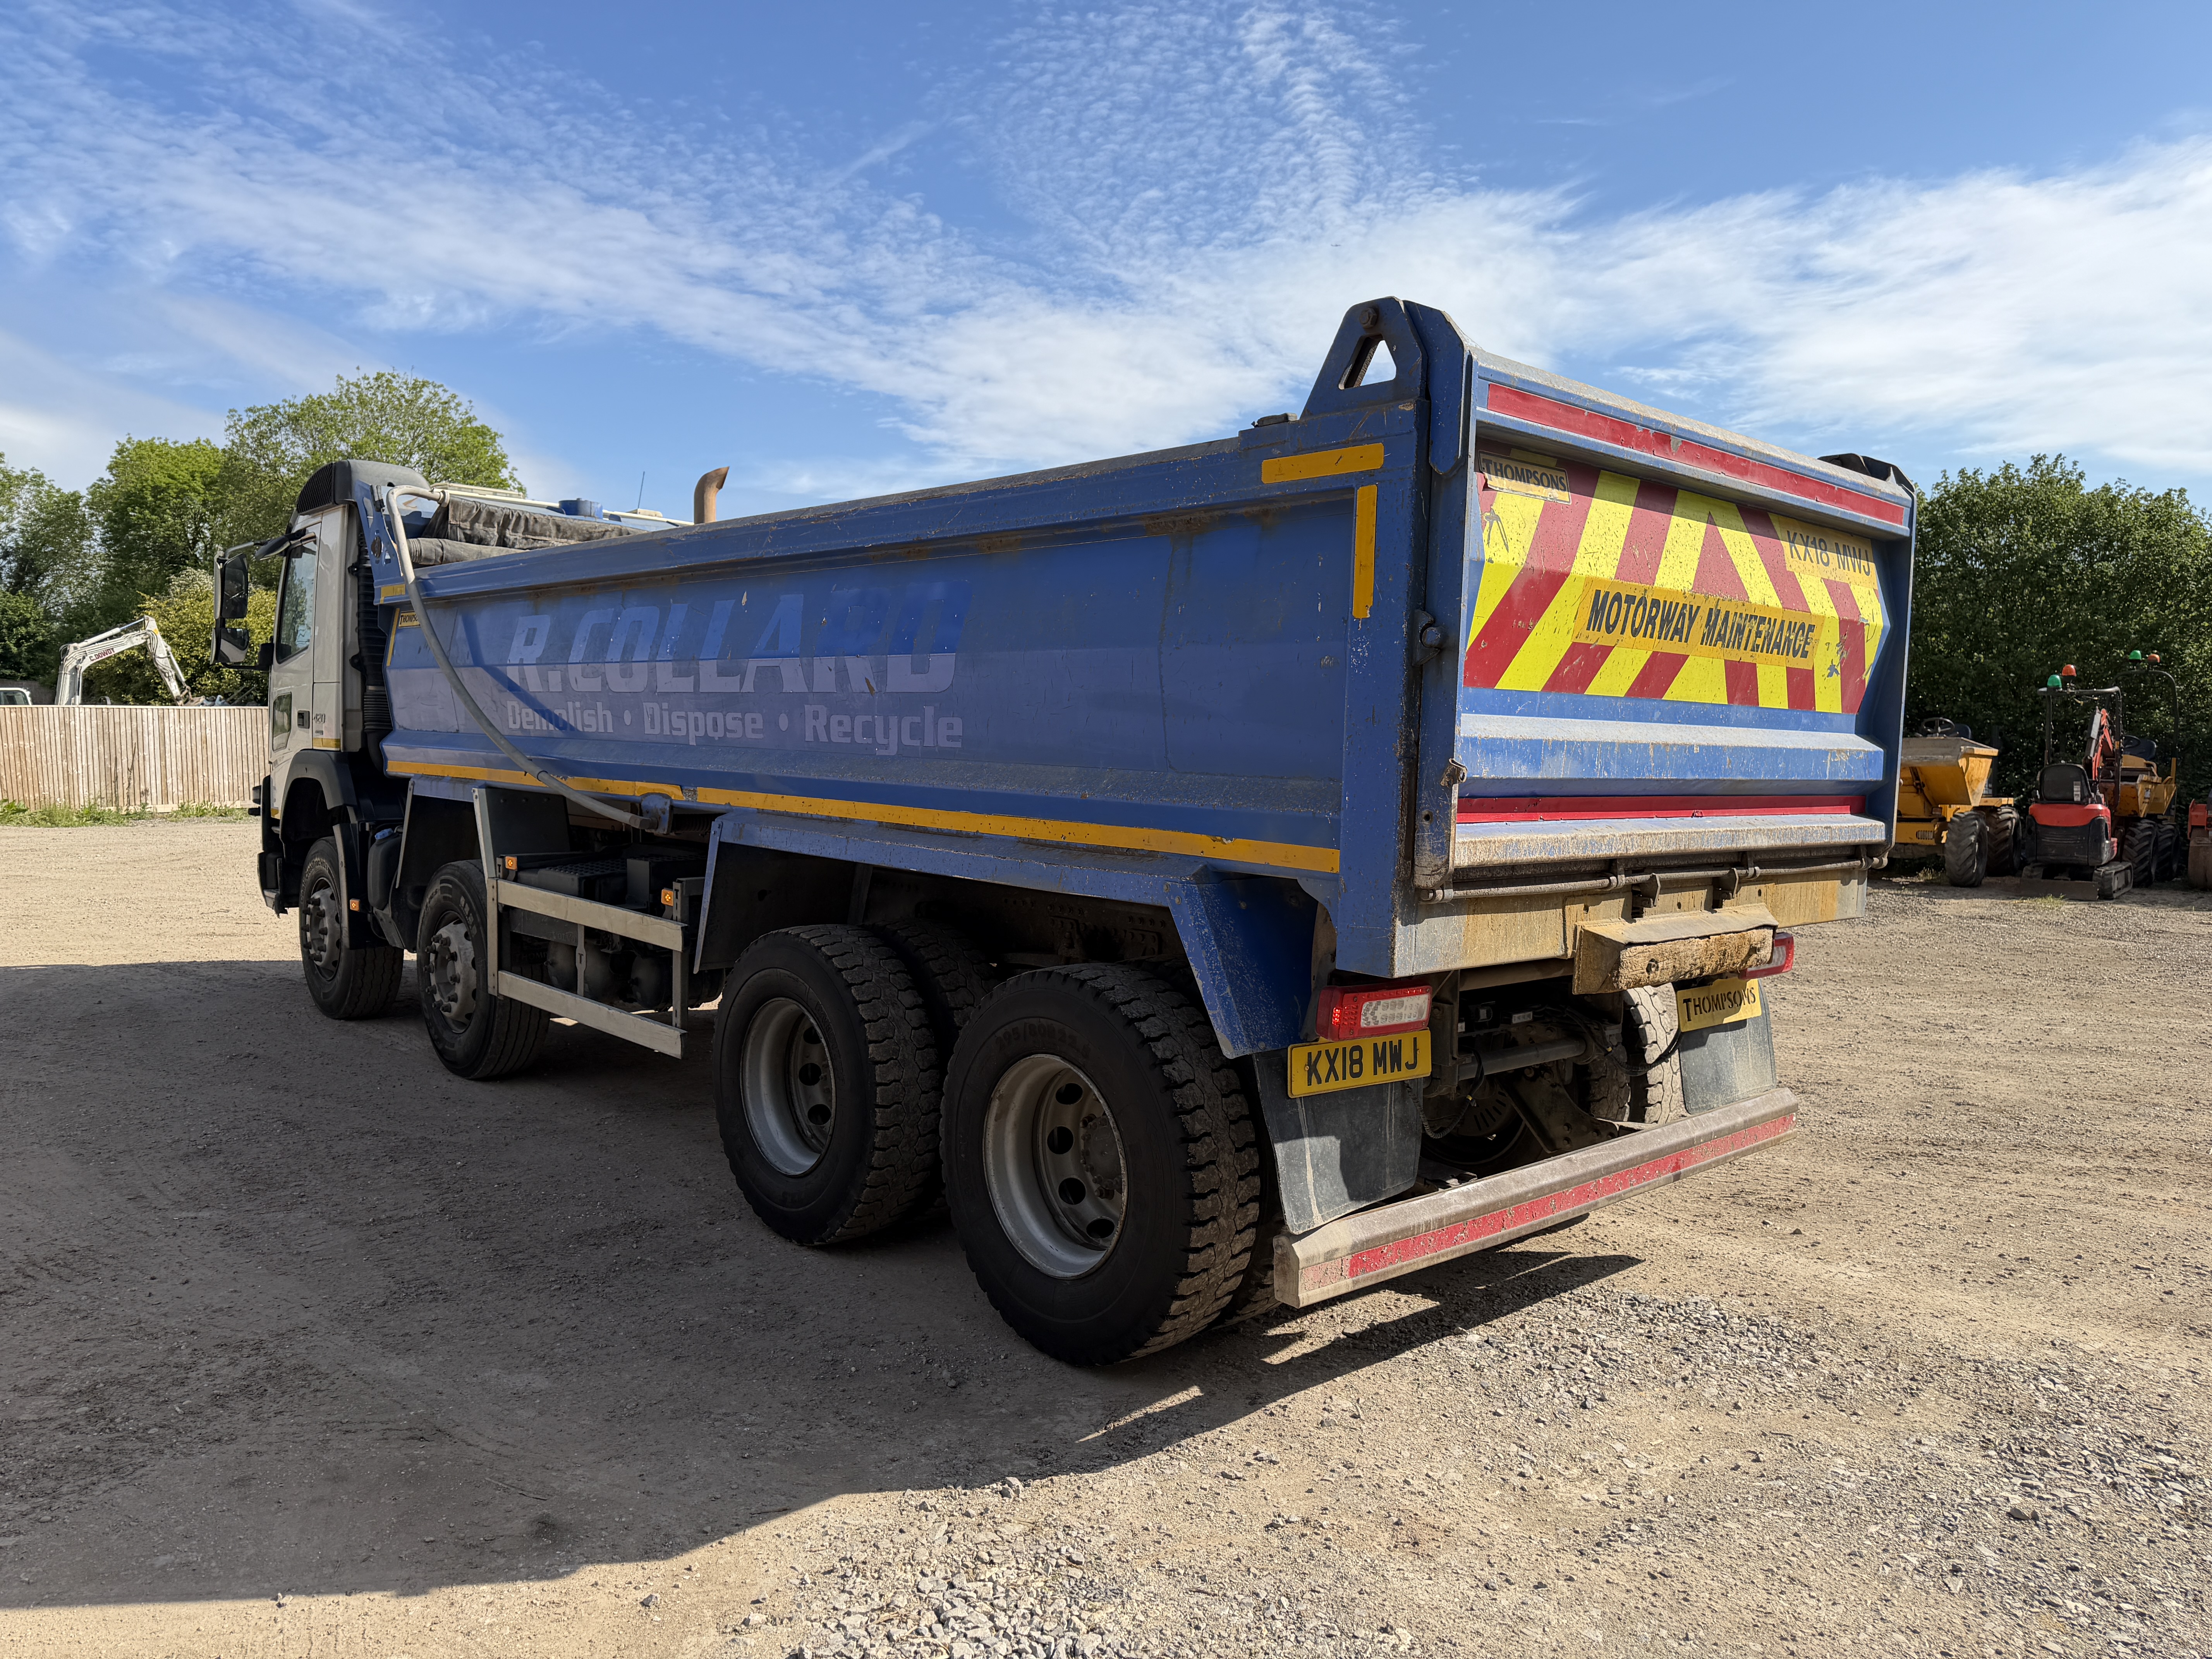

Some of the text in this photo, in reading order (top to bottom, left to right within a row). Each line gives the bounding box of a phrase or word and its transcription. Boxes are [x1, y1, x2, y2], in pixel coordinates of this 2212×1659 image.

[1482, 458, 1567, 492] THOMPSONS
[1787, 530, 1870, 576] KX18 MWJ
[507, 581, 972, 692] R.COLLARD
[1586, 589, 1815, 659] MOTORWAY MAINTENANCE
[507, 701, 963, 756] Demolish Dispose Recycle
[1683, 987, 1756, 1022] THOMPSONS
[1307, 1037, 1417, 1086] KX18 MWJ
